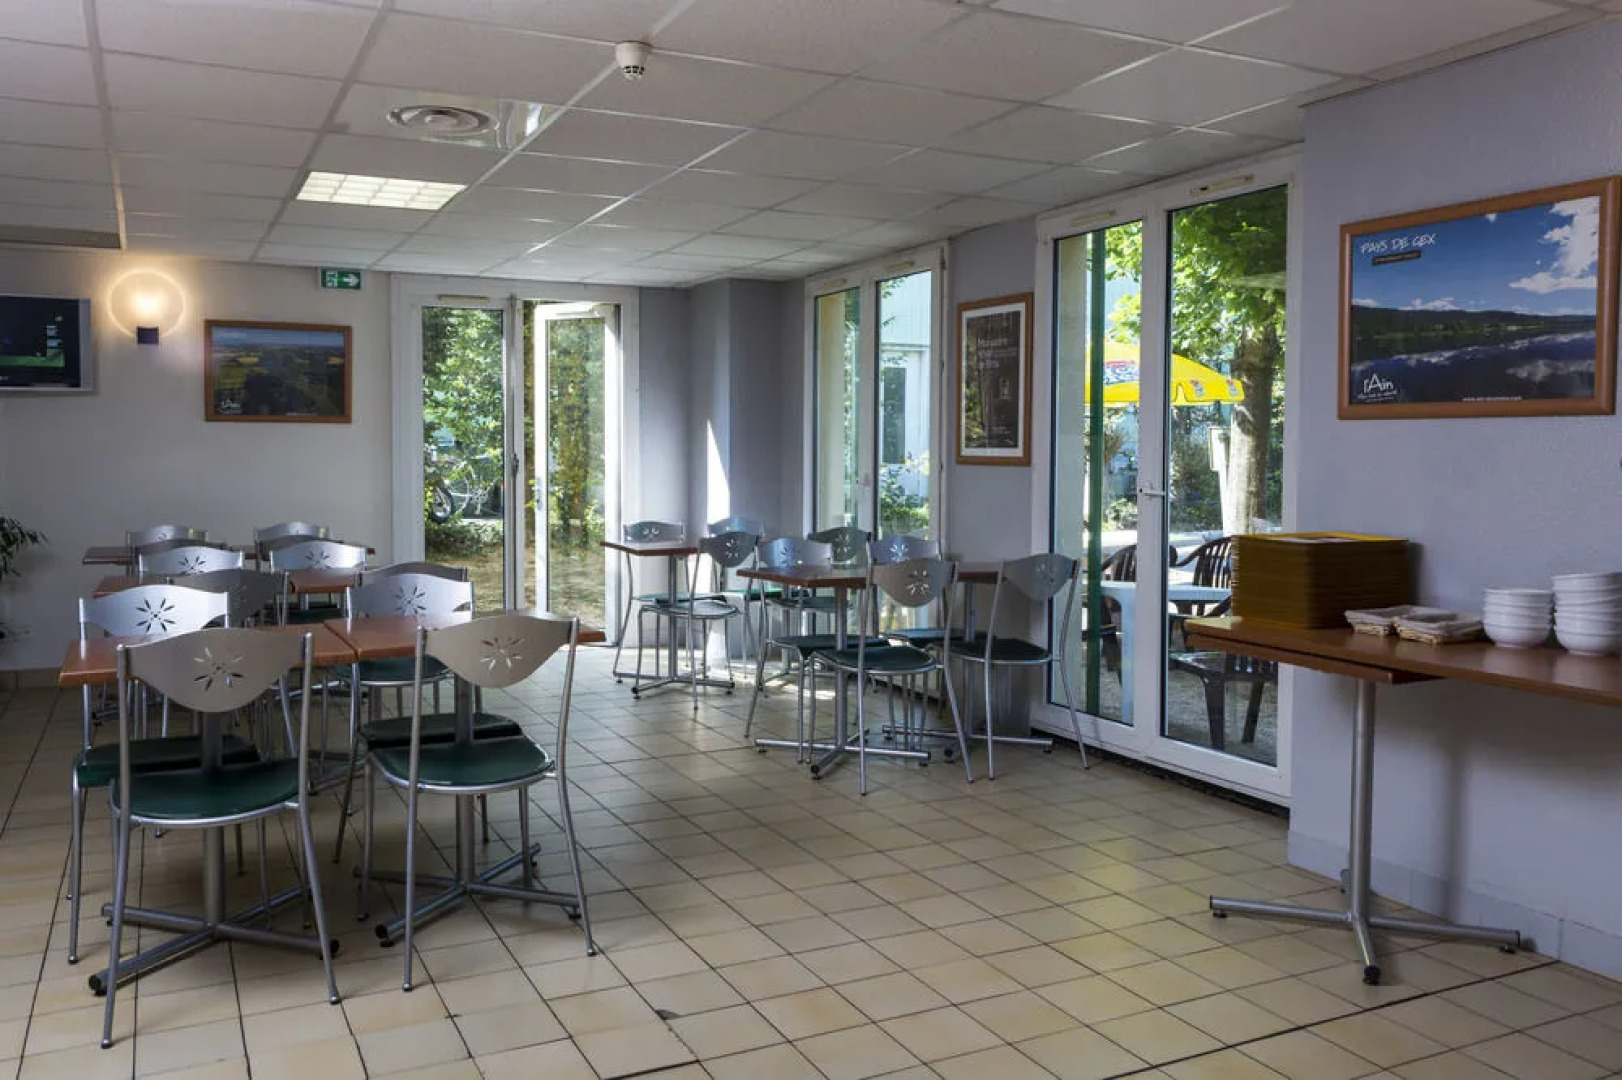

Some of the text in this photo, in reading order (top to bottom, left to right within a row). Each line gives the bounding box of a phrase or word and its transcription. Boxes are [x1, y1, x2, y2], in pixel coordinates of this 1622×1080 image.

[1361, 233, 1436, 254] PAYS DE GEX
